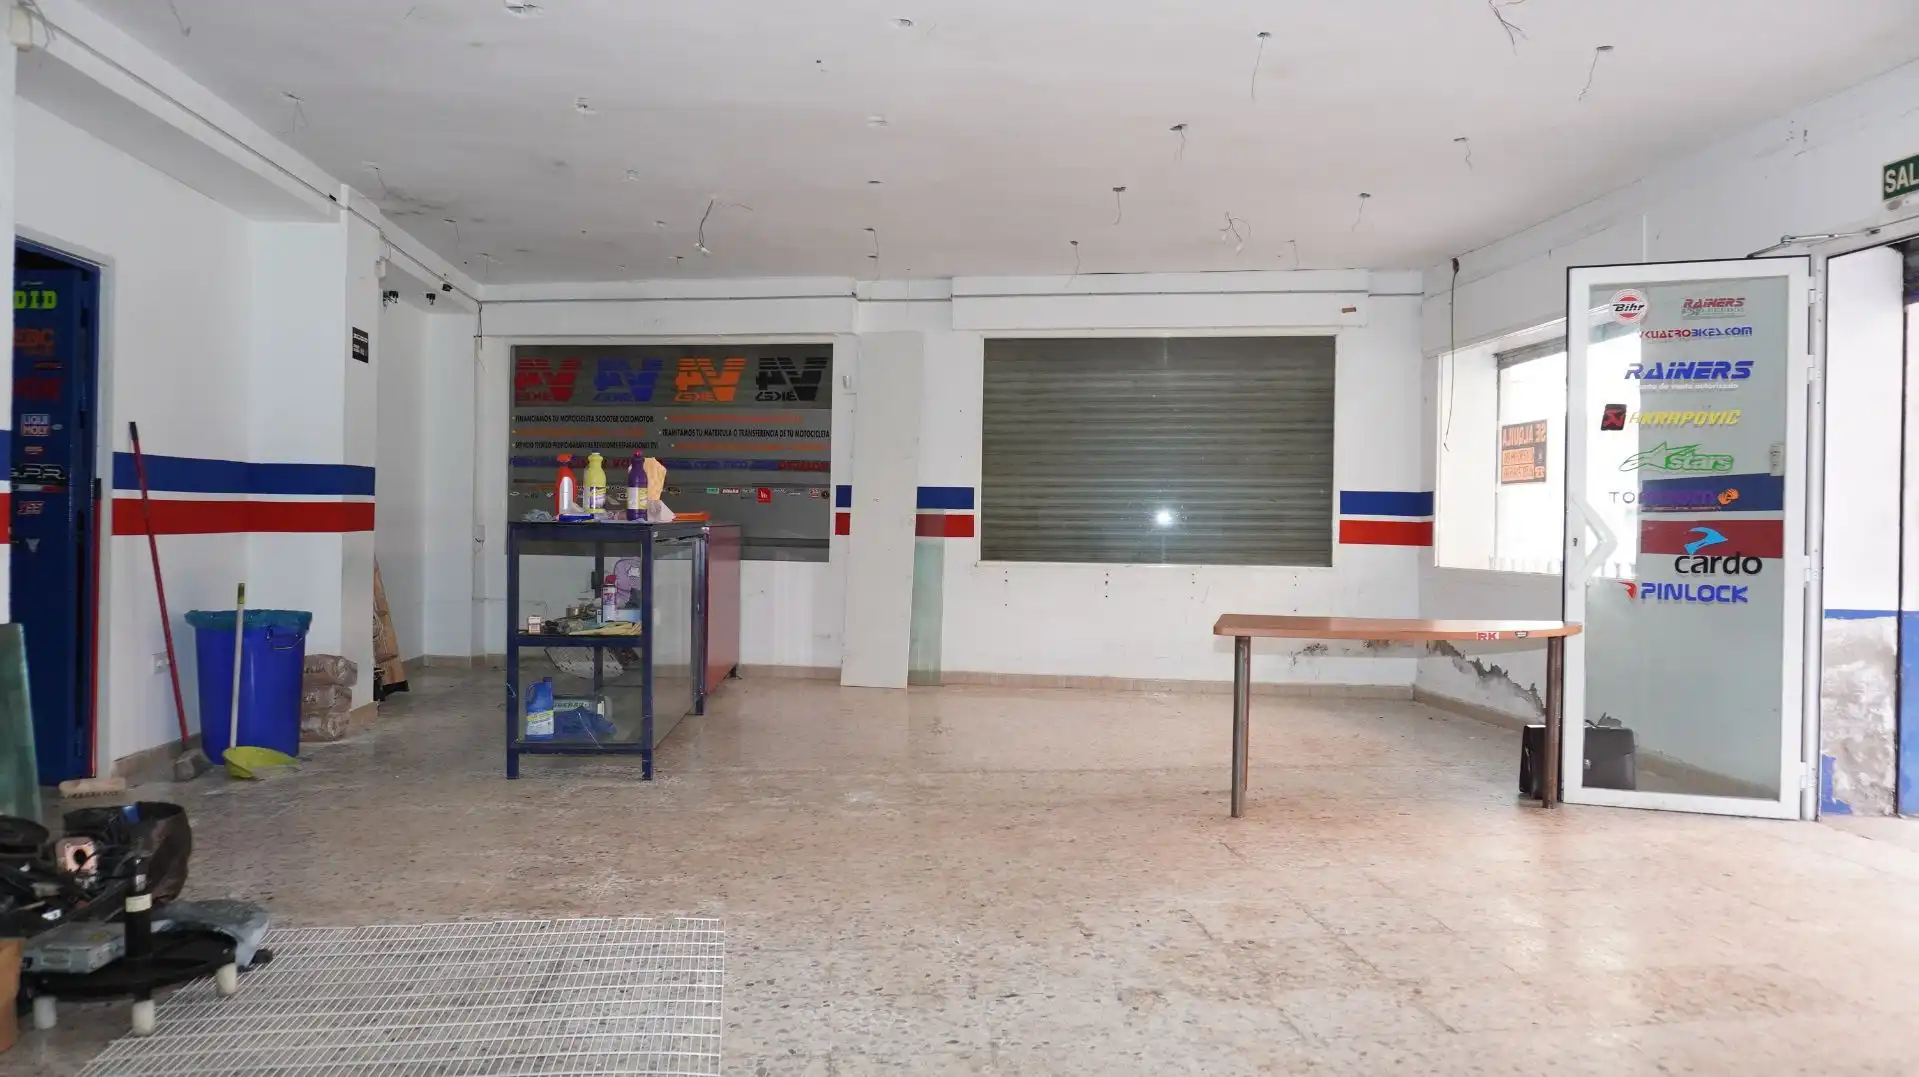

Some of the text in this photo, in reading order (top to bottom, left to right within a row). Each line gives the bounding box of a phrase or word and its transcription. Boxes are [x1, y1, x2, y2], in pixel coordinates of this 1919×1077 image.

[13, 290, 58, 309] DID
[1613, 302, 1645, 313] Bihr
[1683, 297, 1745, 308] RAINERS
[1624, 360, 1755, 380] RAINERS
[1674, 551, 1763, 575] cardo
[1640, 582, 1749, 603] PINLOCK
[1477, 632, 1497, 640] RK
